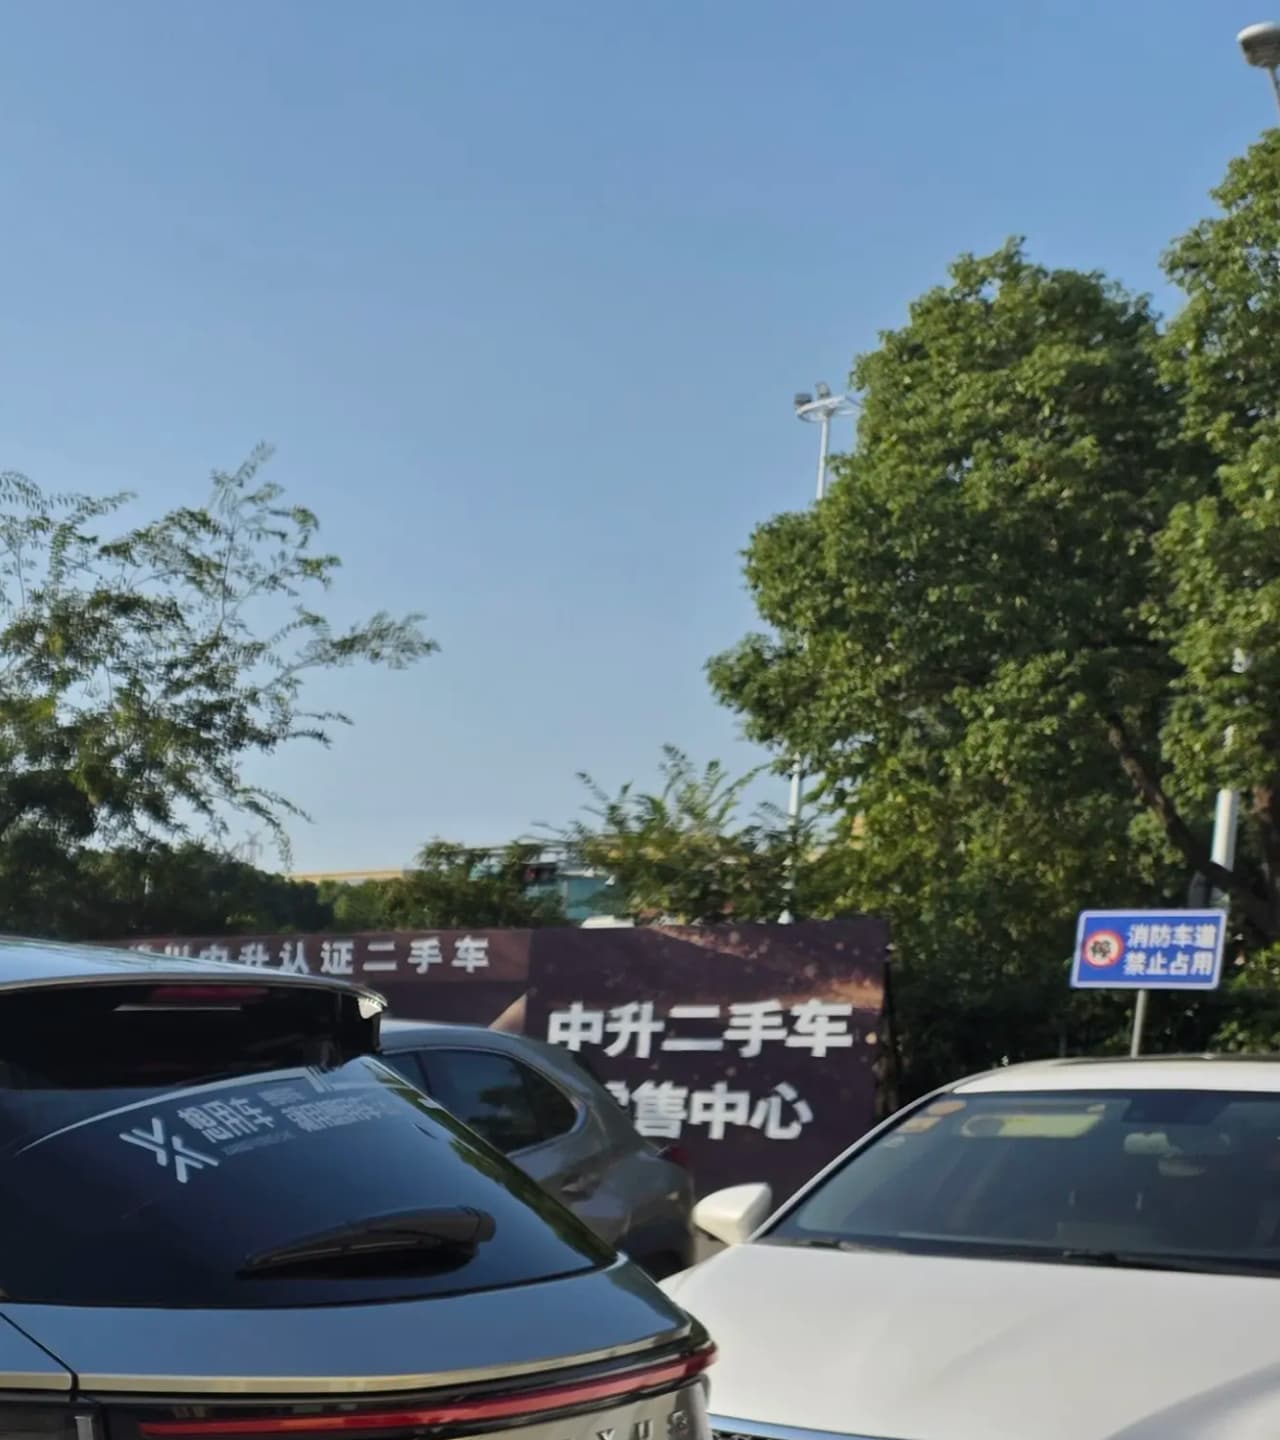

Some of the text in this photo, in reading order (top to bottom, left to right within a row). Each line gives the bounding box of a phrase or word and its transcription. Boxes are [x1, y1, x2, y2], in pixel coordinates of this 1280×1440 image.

[129, 935, 490, 975] 中升认证二手车
[1127, 923, 1217, 949] 消防车道
[1123, 951, 1214, 976] 禁止占用
[547, 998, 854, 1058] 中升二手车
[605, 1080, 814, 1139] 售中心
